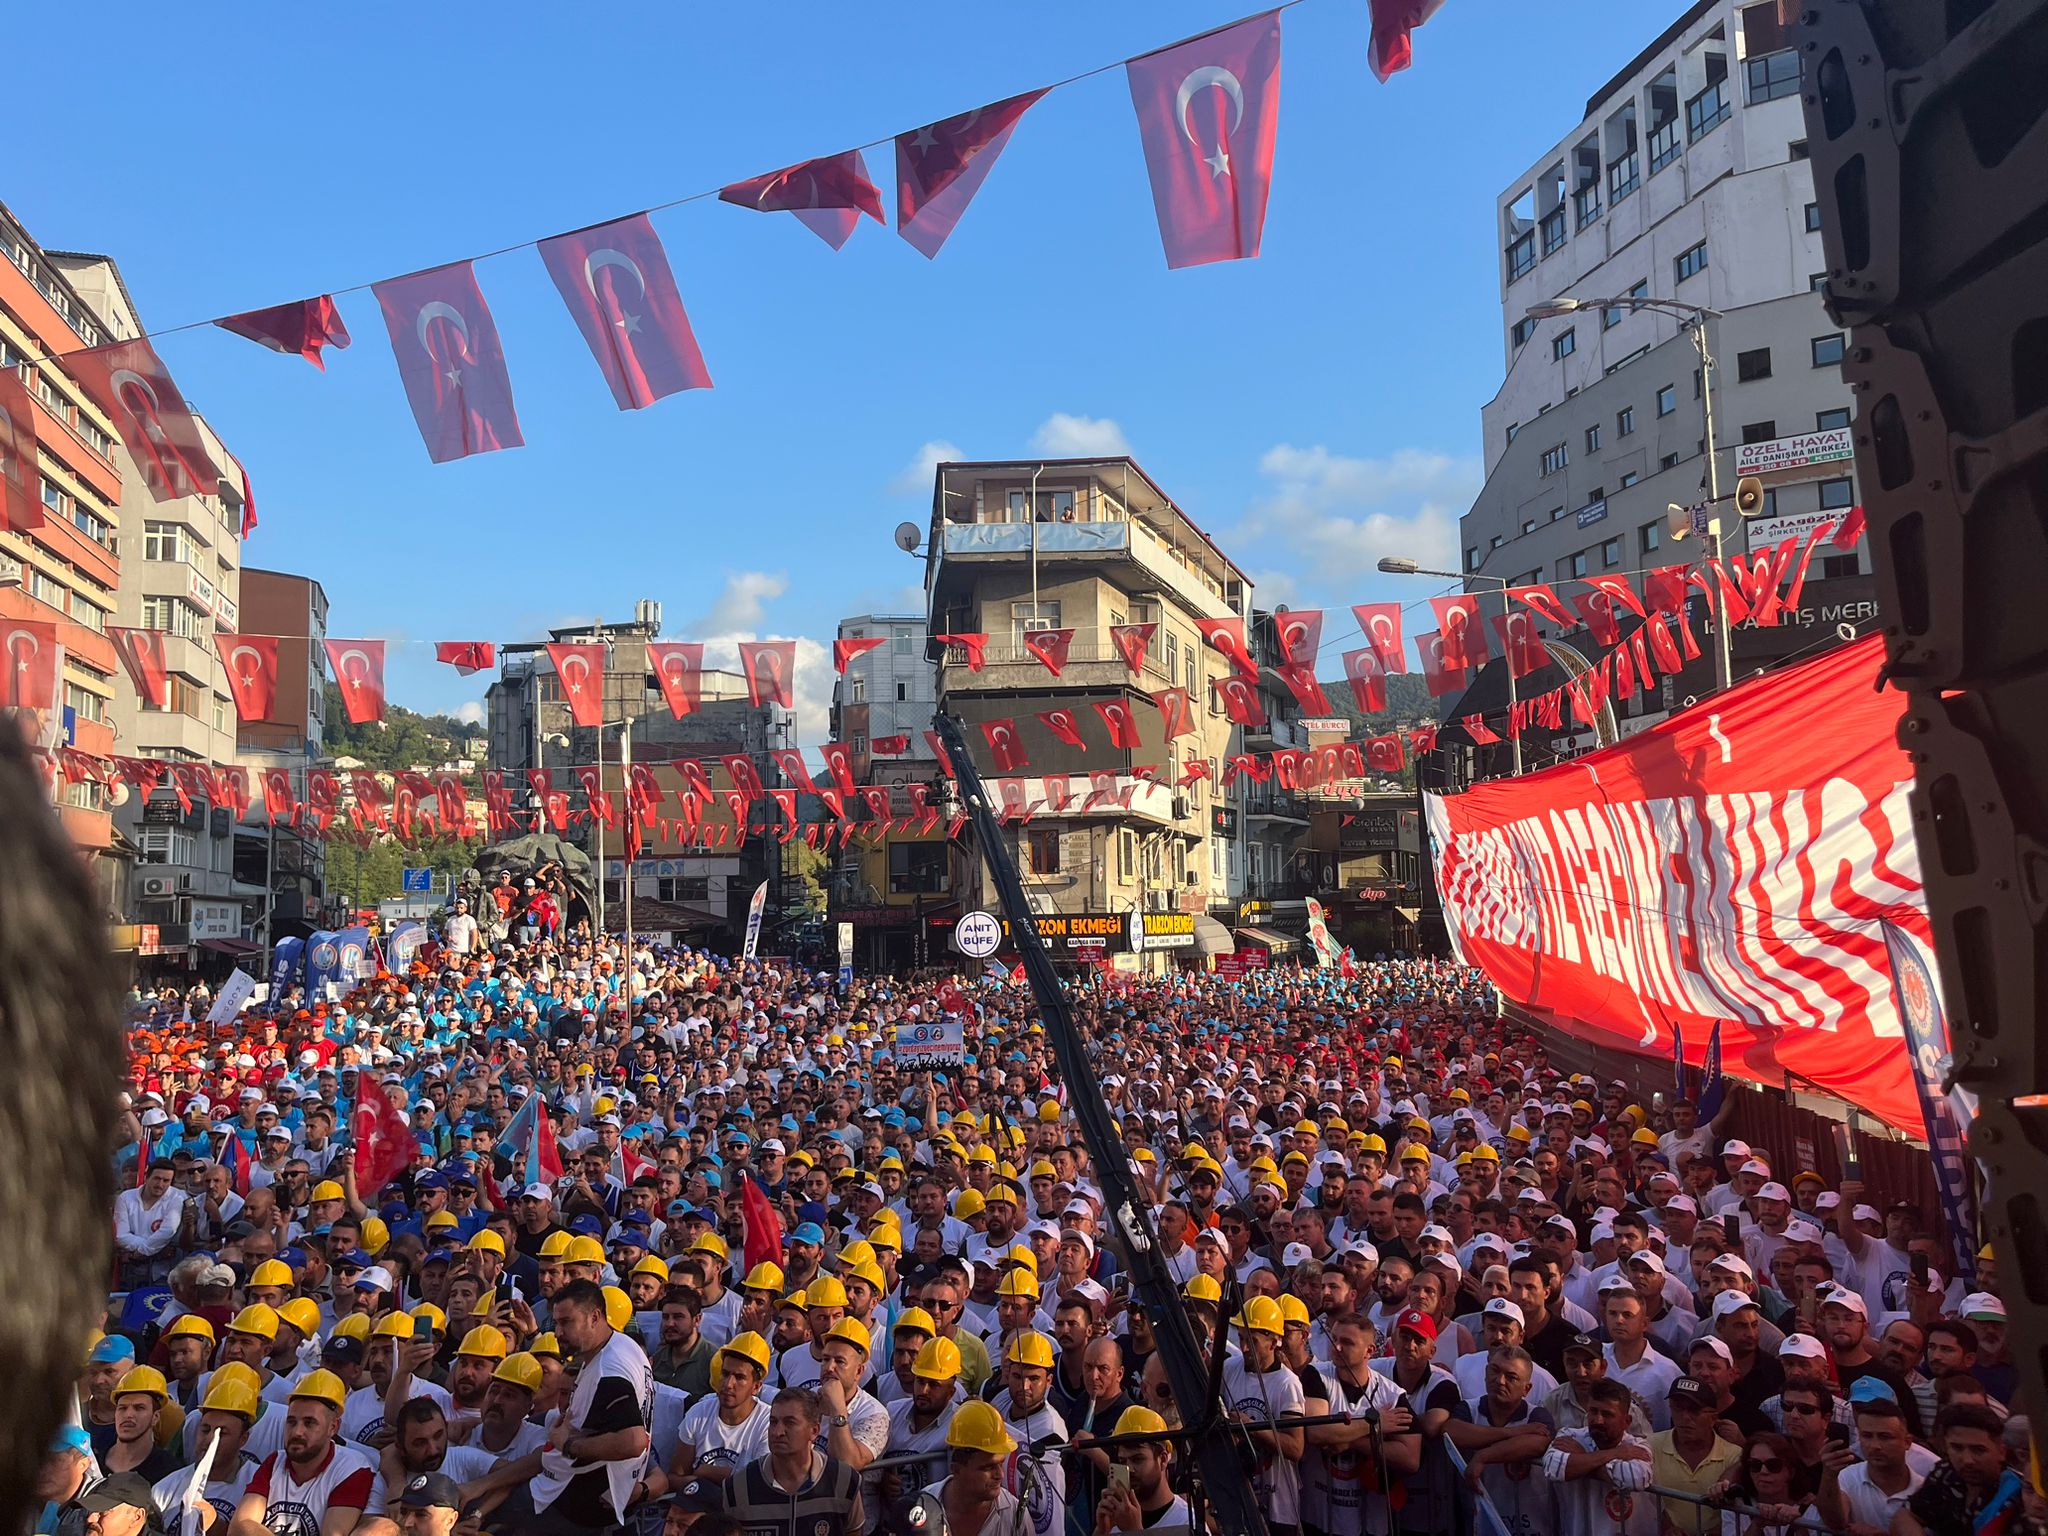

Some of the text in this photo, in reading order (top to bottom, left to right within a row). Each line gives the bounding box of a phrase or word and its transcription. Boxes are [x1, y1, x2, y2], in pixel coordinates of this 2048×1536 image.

[1740, 441, 1850, 466] AİLE DANIŞMA MERKEZİ
[1743, 432, 1847, 457] ÖZEL HAYAT
[1359, 887, 1386, 901] dyo
[964, 924, 993, 932] ANIT
[1071, 915, 1121, 935] EKMEĞİ
[1143, 914, 1173, 934] TRABZON
[963, 934, 993, 945] BÜFE
